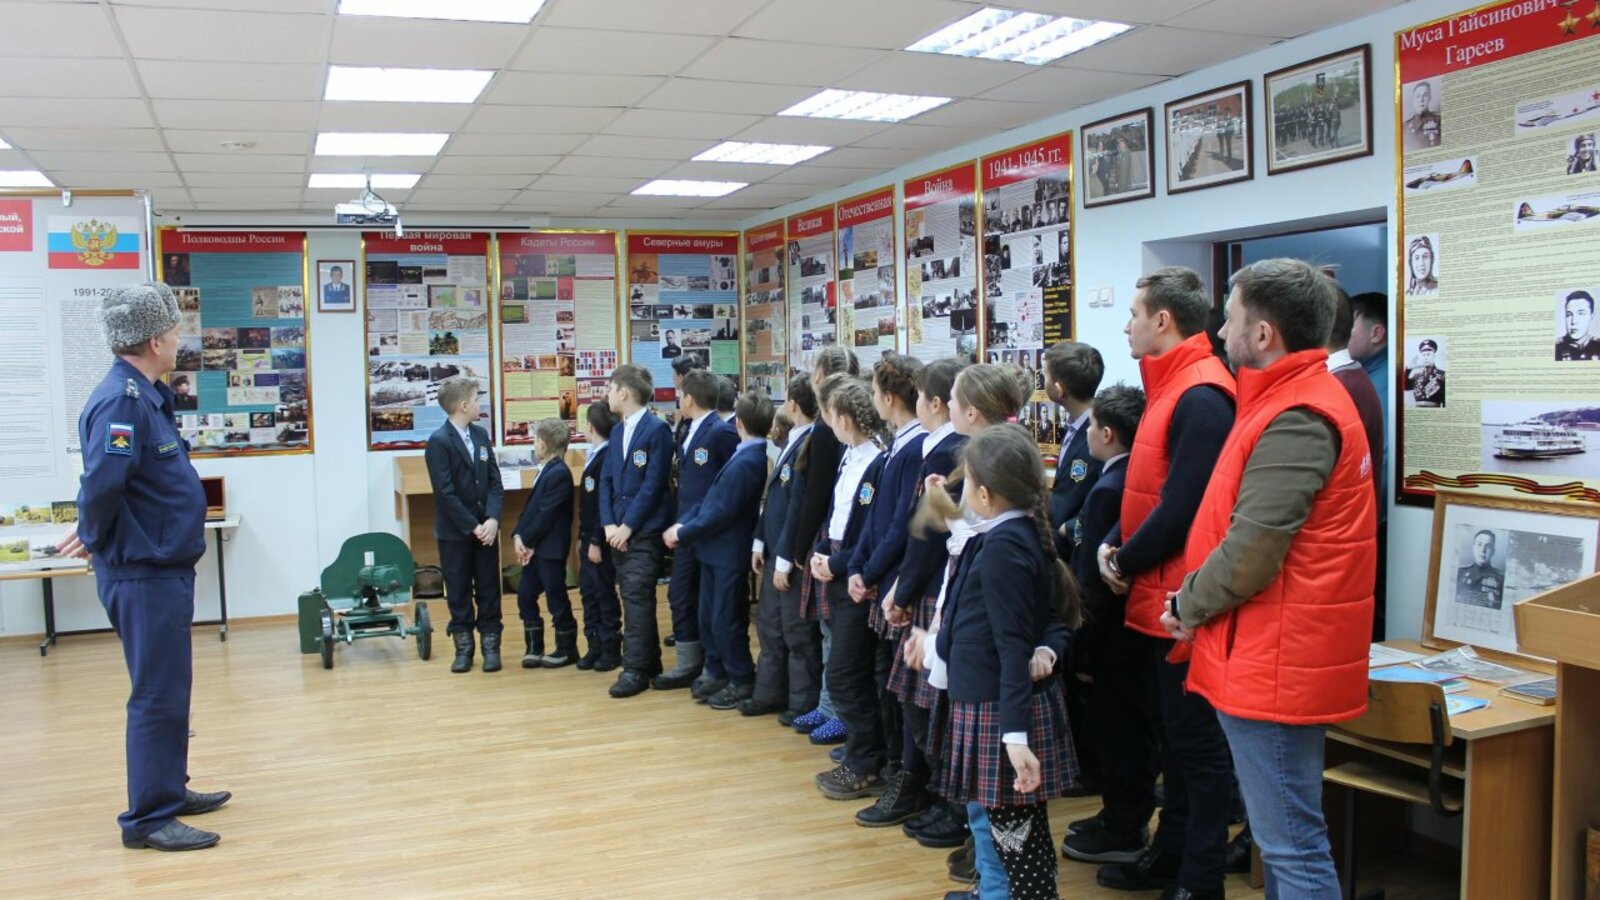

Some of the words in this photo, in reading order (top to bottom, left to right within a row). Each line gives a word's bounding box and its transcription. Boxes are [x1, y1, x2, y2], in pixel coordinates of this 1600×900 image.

[1400, 27, 1444, 51] Муса
[1445, 38, 1505, 65] Гареев
[989, 147, 1045, 180] 1941-1945
[1048, 148, 1062, 164] гг.
[924, 178, 953, 196] Война
[838, 195, 892, 221] Отечественная
[182, 234, 246, 245] Полководцы
[249, 234, 285, 244] России
[424, 231, 472, 242] мировая
[520, 237, 558, 248] Кадеты
[560, 237, 595, 247] России
[643, 236, 691, 249] Северные
[692, 239, 724, 250] амуры
[409, 242, 444, 252] война
